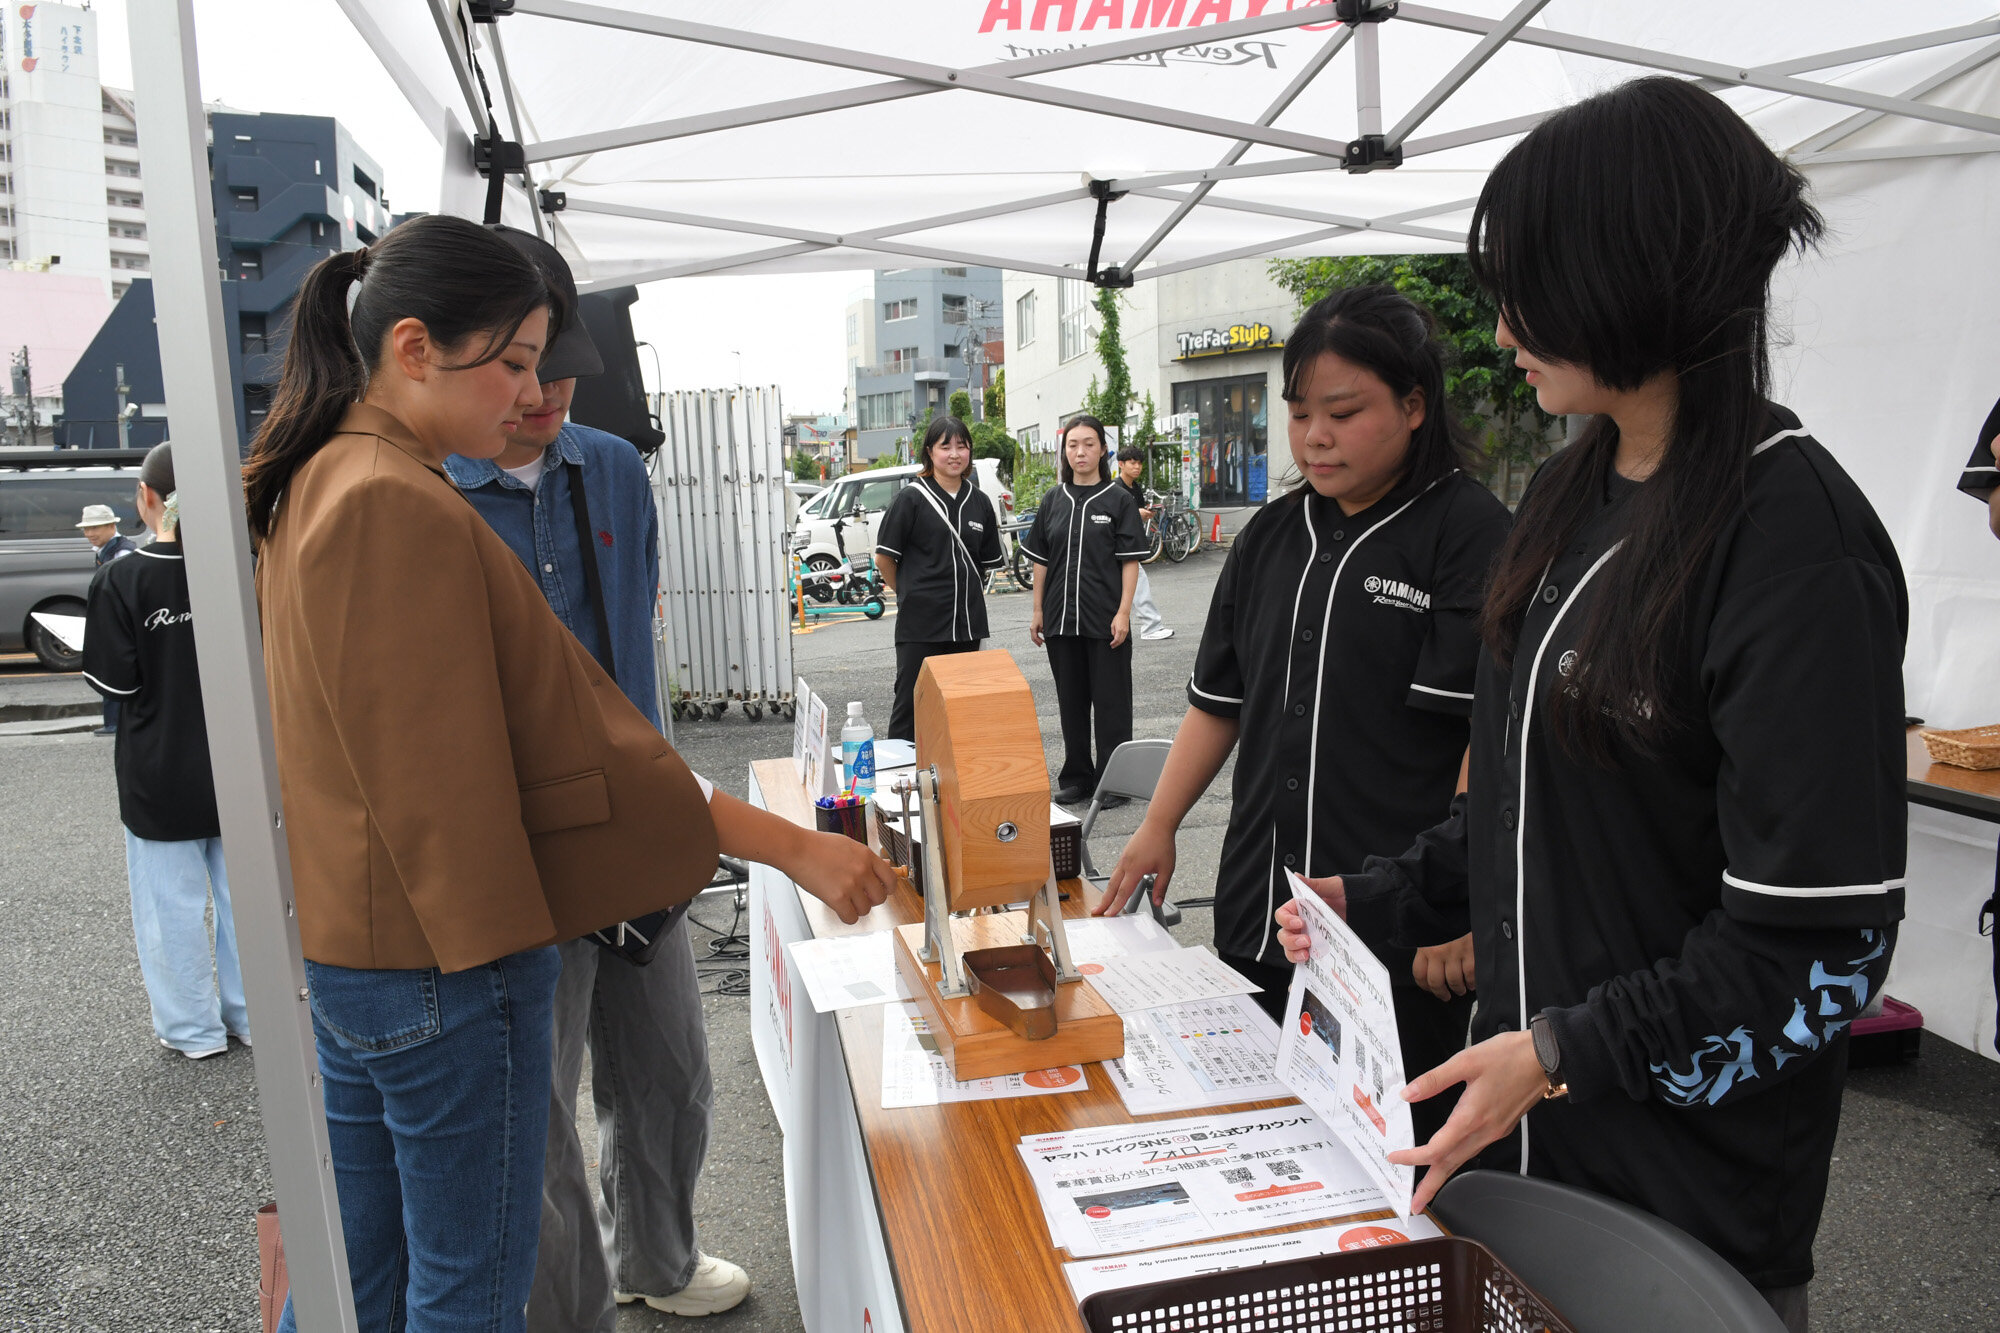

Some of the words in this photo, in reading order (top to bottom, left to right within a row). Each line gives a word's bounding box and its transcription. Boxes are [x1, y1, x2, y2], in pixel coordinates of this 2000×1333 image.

[61, 26, 69, 72] ハイタウン
[1177, 322, 1272, 351] TreFacStyle
[1382, 579, 1431, 609] YAMAHA
[1041, 1151, 1089, 1163] ヤマハ
[1096, 1137, 1172, 1156] バイクSNS
[1208, 1116, 1313, 1139] 公式アカウント
[1140, 1142, 1238, 1162] フォローで
[1101, 1262, 1128, 1271] YAMAHA
[1154, 1255, 1188, 1265] Yamaha
[1189, 1248, 1238, 1260] Motorcycle
[1238, 1242, 1281, 1253] Exhibition
[1281, 1239, 1302, 1247] 2026
